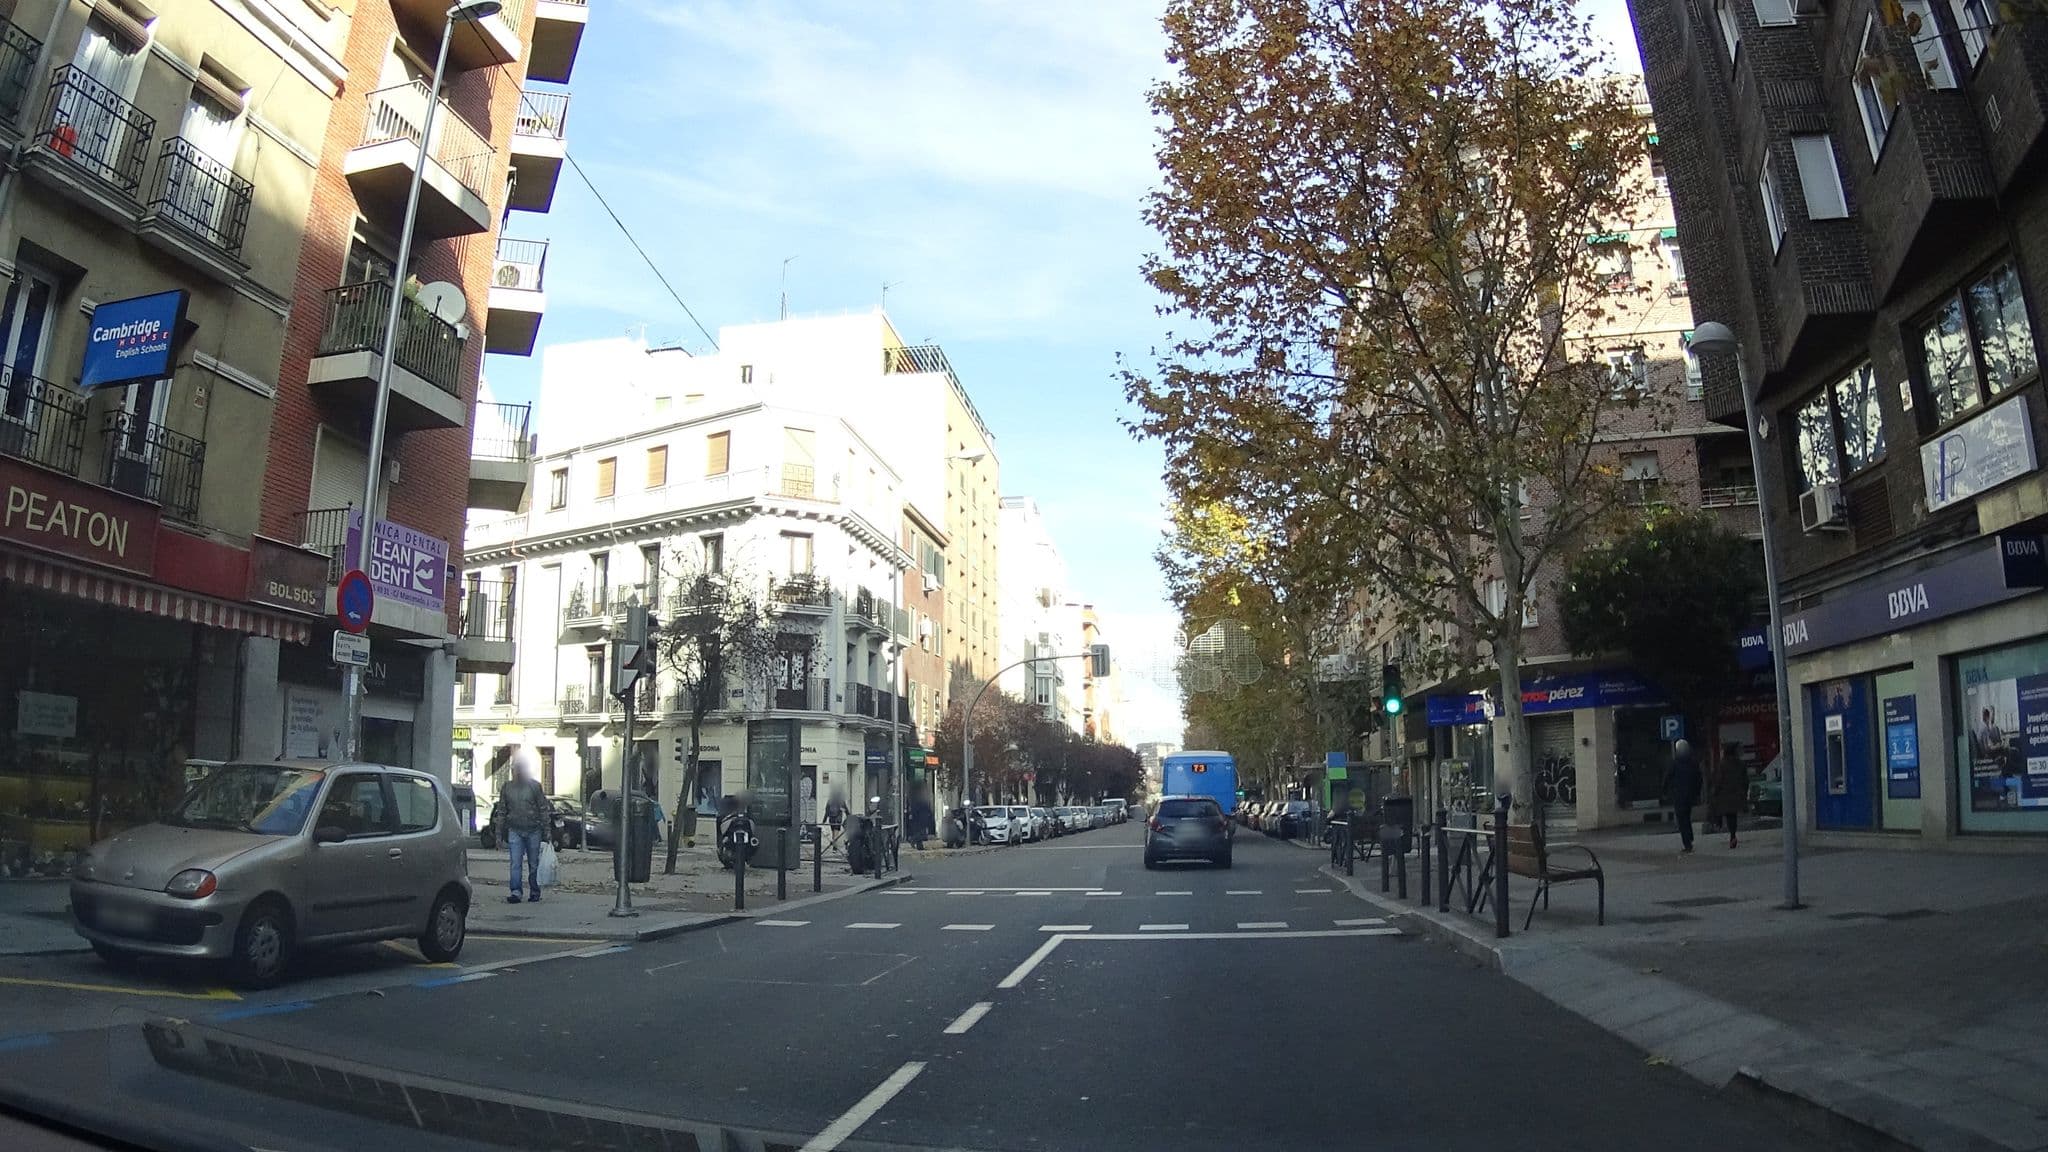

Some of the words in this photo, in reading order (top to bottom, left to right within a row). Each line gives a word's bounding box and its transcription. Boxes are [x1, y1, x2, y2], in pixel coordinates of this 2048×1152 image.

[93, 318, 160, 343] Cambridge
[119, 331, 169, 347] HOUSE
[116, 346, 140, 359] English
[140, 342, 167, 356] Schools
[5, 486, 129, 558] PEATON
[357, 514, 400, 541] CNICA
[405, 532, 442, 555] DENTAL
[373, 536, 411, 567] LEAN
[2006, 540, 2039, 556] BBVA
[371, 561, 410, 588] DENT
[269, 580, 316, 606] BOLSOS
[1888, 583, 1929, 619] BBVA
[1741, 635, 1764, 648] BBVA
[1548, 686, 1584, 703] pérez
[1665, 718, 1679, 737] P
[1193, 764, 1205, 773] 73
